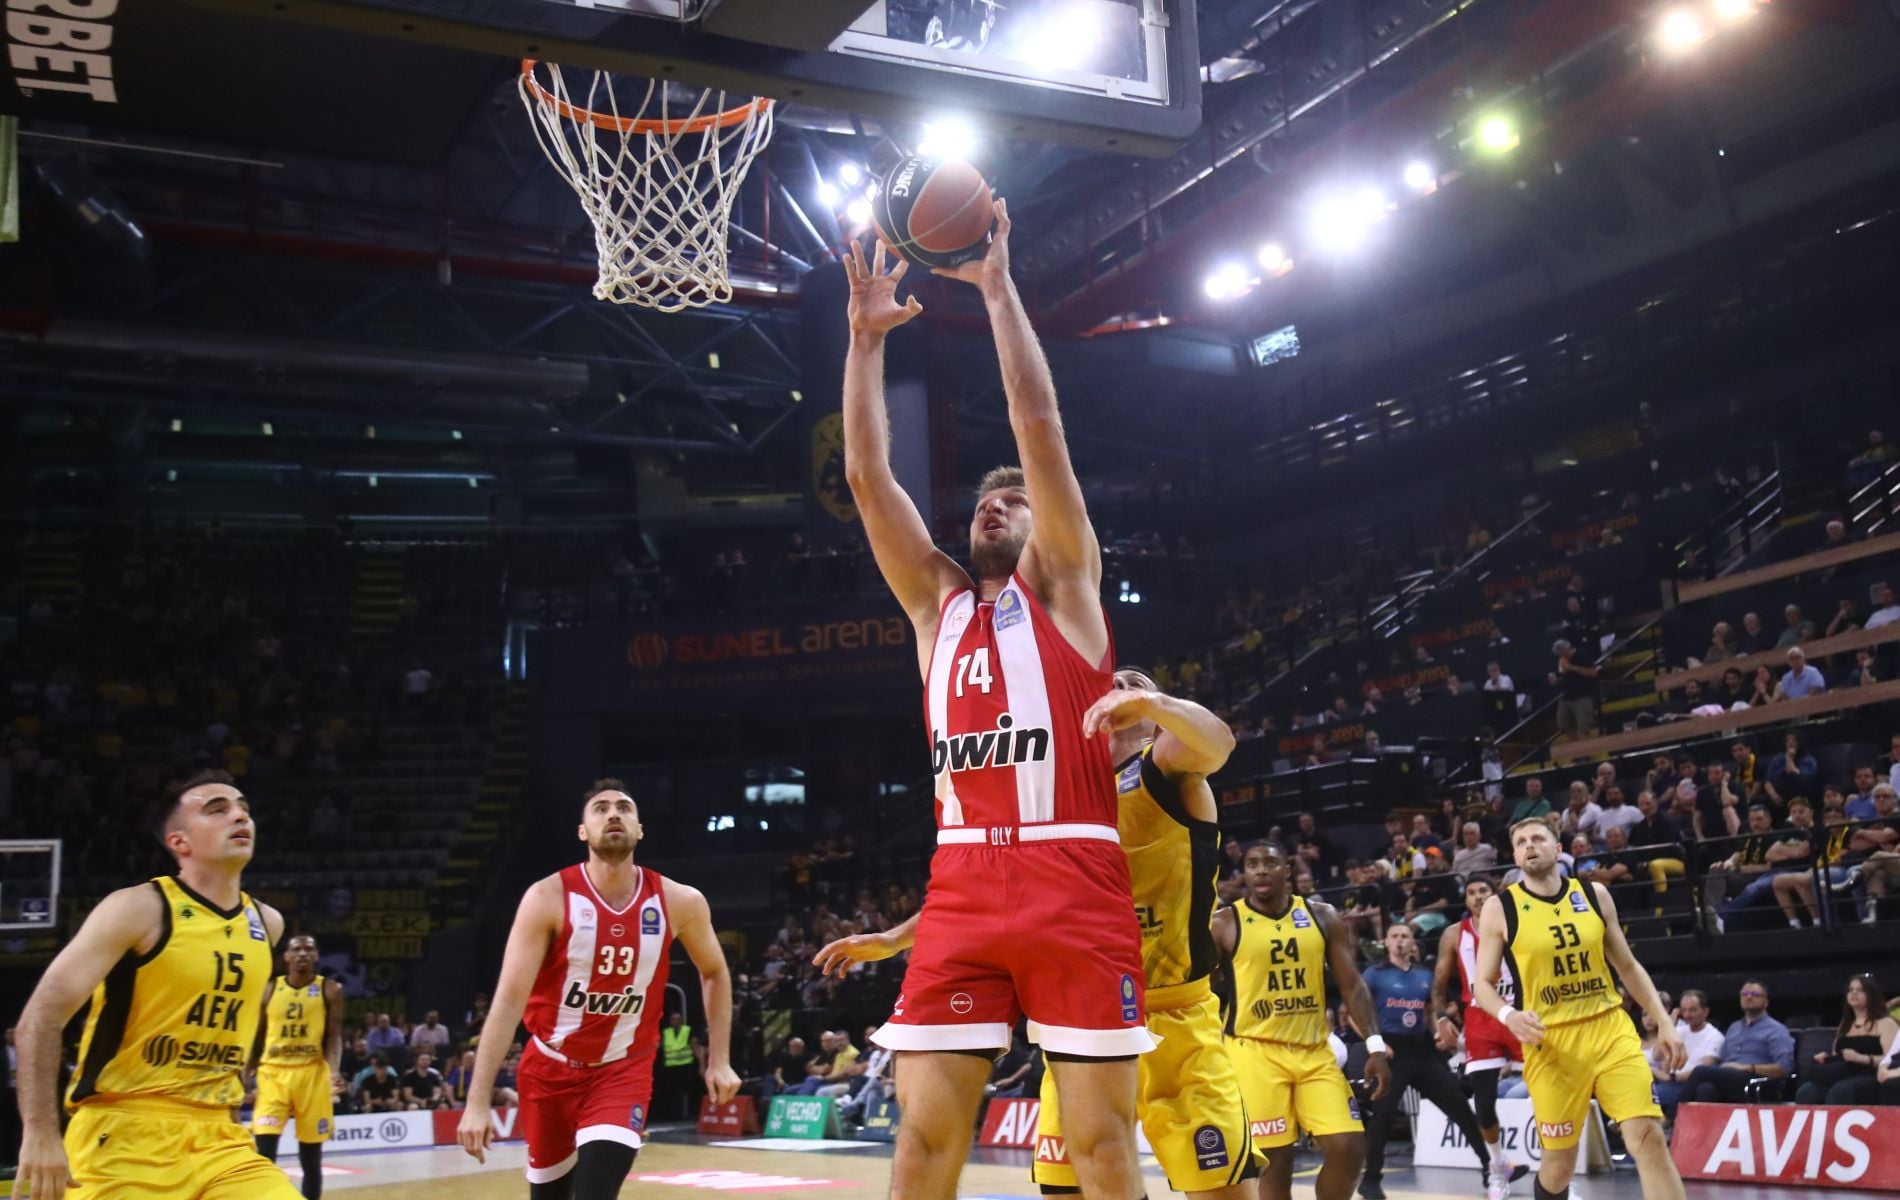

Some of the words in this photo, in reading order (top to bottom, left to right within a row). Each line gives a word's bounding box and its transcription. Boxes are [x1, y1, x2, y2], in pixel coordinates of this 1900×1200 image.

[675, 628, 796, 663] SUNEL
[801, 617, 906, 652] arena
[955, 646, 993, 698] 14
[932, 712, 1050, 776] bwin
[990, 826, 1013, 846] OLY
[1548, 922, 1581, 951] 33
[597, 945, 635, 976] 33
[1269, 937, 1300, 965] 24
[1553, 951, 1592, 978] AEK
[213, 951, 245, 993] 15
[1268, 967, 1307, 992] AEK
[564, 981, 644, 1016] bwin
[1559, 977, 1608, 996] SUNEL
[185, 993, 244, 1032] AEK
[285, 1002, 304, 1020] 21
[1274, 995, 1319, 1012] SUNEL
[281, 1023, 309, 1039] AEK
[992, 1101, 1041, 1146] AVI
[1251, 1118, 1287, 1136] AVIS
[1541, 1121, 1573, 1137] AVIS
[1037, 1137, 1067, 1161] AV
[1703, 1109, 1875, 1182] AVIS
